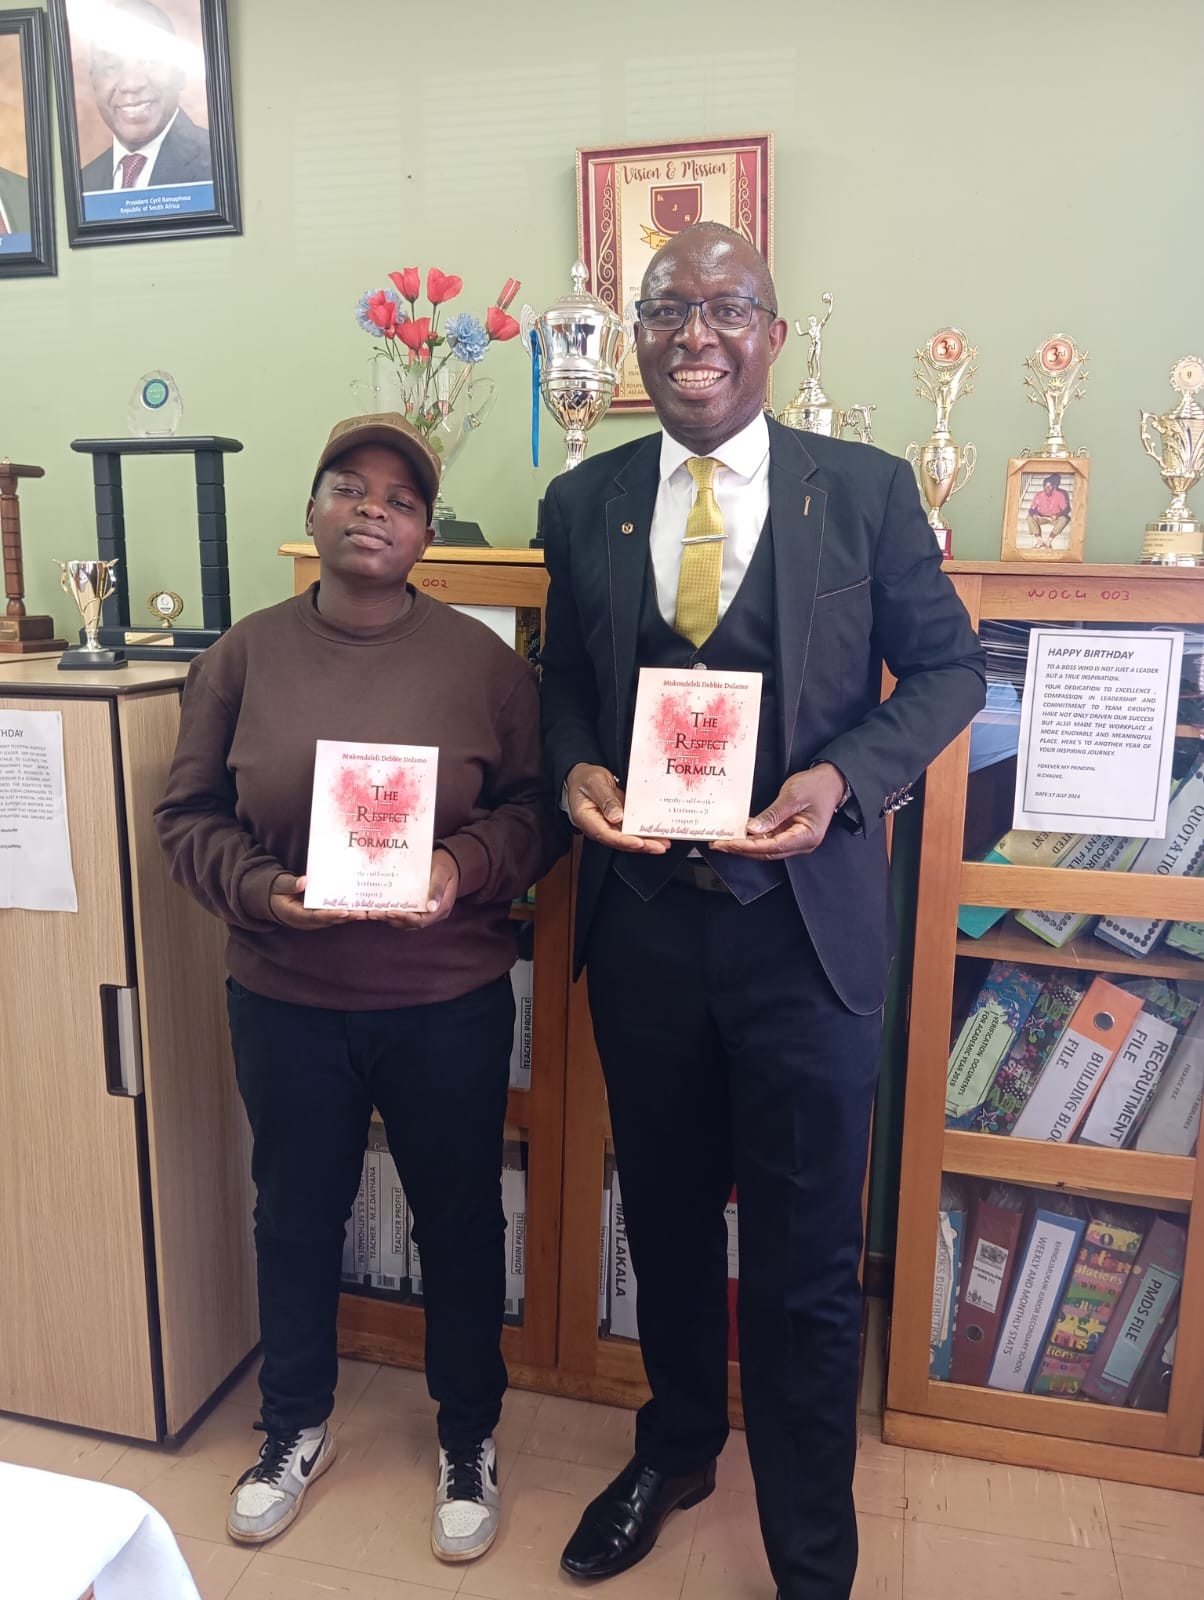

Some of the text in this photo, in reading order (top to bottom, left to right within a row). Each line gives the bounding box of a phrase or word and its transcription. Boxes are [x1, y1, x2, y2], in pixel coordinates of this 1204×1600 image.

[623, 160, 727, 184] Vision & Mission
[150, 198, 161, 206] Cyril
[162, 195, 191, 204] Ramaphosa
[938, 340, 956, 357] 3rd
[1049, 346, 1066, 364] 3rd
[422, 578, 448, 588] 002
[1100, 590, 1130, 600] 003
[1048, 648, 1134, 659] HAPPY BIRTHDAY
[691, 712, 718, 728] THE
[0, 730, 24, 738] HDAY
[675, 733, 728, 750] RESPECT
[666, 758, 726, 776] FORMULA
[371, 785, 398, 801] THE
[357, 806, 409, 823] RESPECT
[348, 831, 408, 849] FORMULA
[523, 1029, 532, 1068] TEACHER
[950, 1011, 990, 1087] FOR ACADEMIC YEAR 2019
[1056, 1038, 1079, 1069] FILE
[1122, 1030, 1148, 1063] FILE
[958, 1016, 999, 1096] VERIFICATION DOCUMENTS
[1064, 1052, 1104, 1112] BUILDING
[1110, 1040, 1168, 1142] RECRUITMENT
[1003, 1237, 1048, 1355] WEEKLY AND MONTHLY STATS
[1125, 1279, 1162, 1342] PMDS FILE
